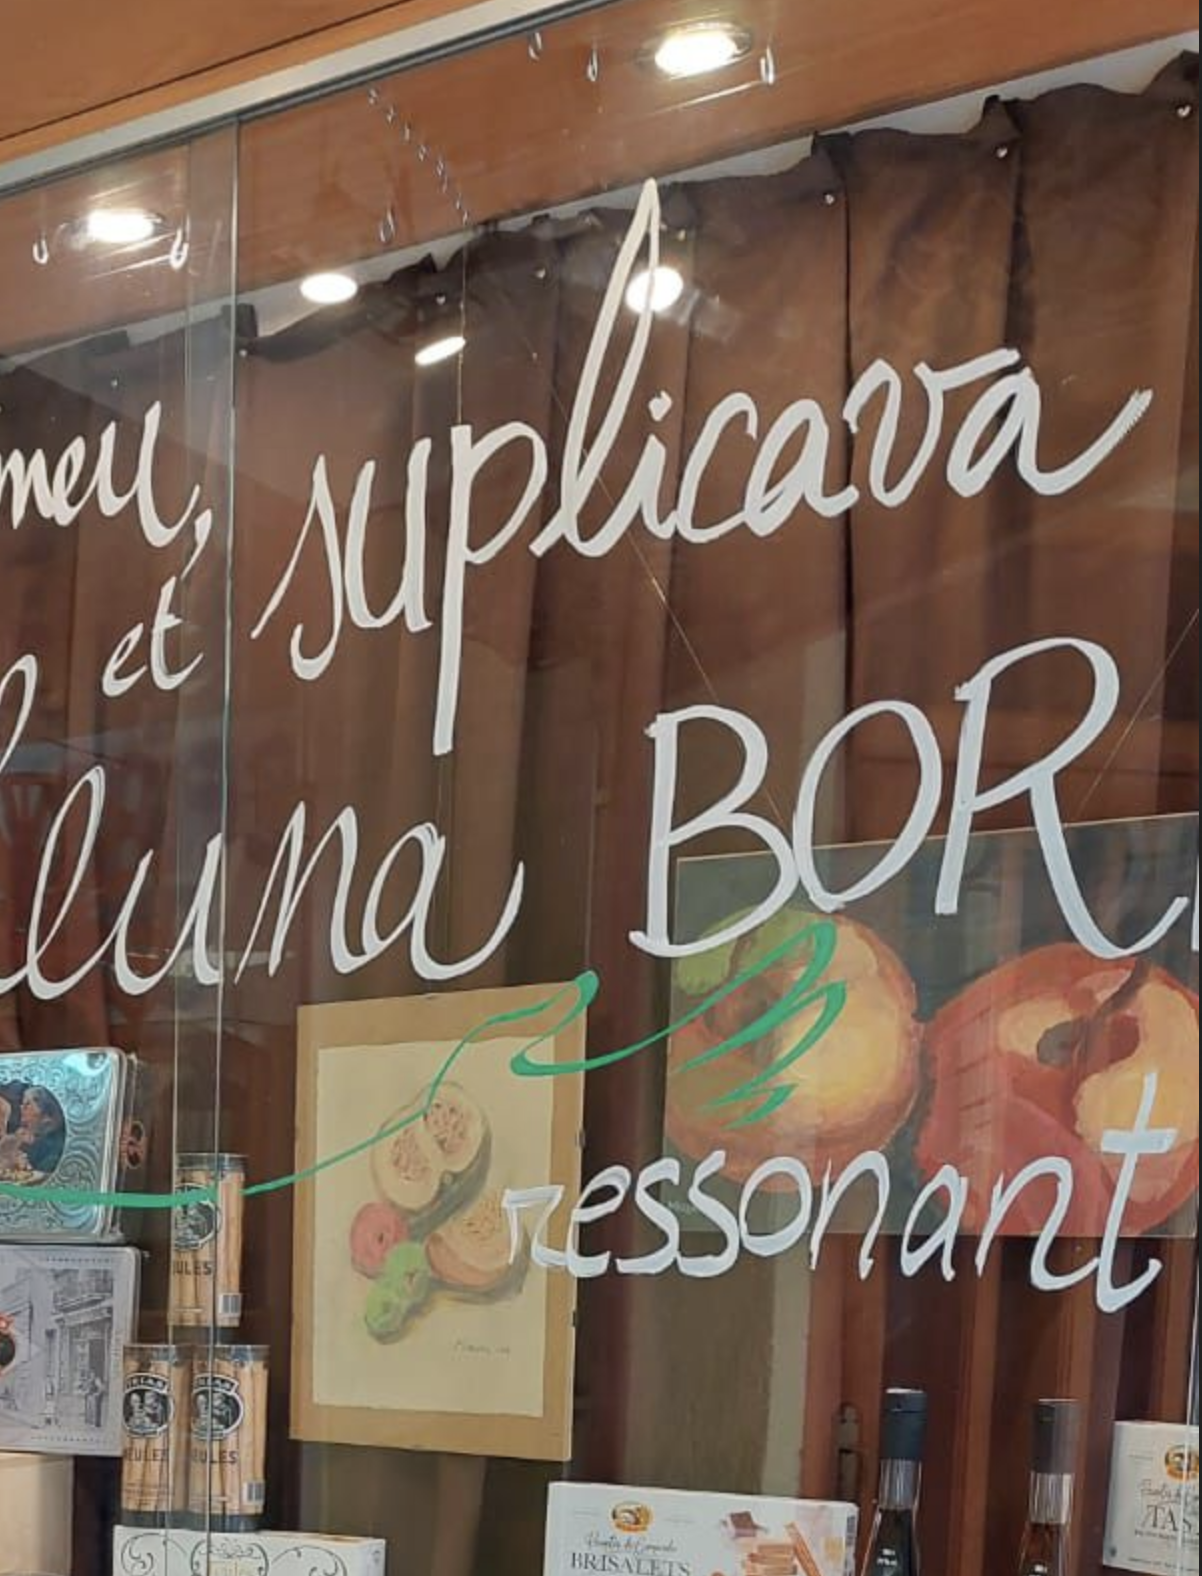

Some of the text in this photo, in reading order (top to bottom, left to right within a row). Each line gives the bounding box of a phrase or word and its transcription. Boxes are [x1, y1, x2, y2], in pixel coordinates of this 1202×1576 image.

[251, 178, 1152, 756] suplicava
[101, 576, 204, 698] et
[629, 637, 1199, 958] BOR
[501, 1070, 1163, 1314] ressonant
[571, 1551, 691, 1576] BRISALETS
